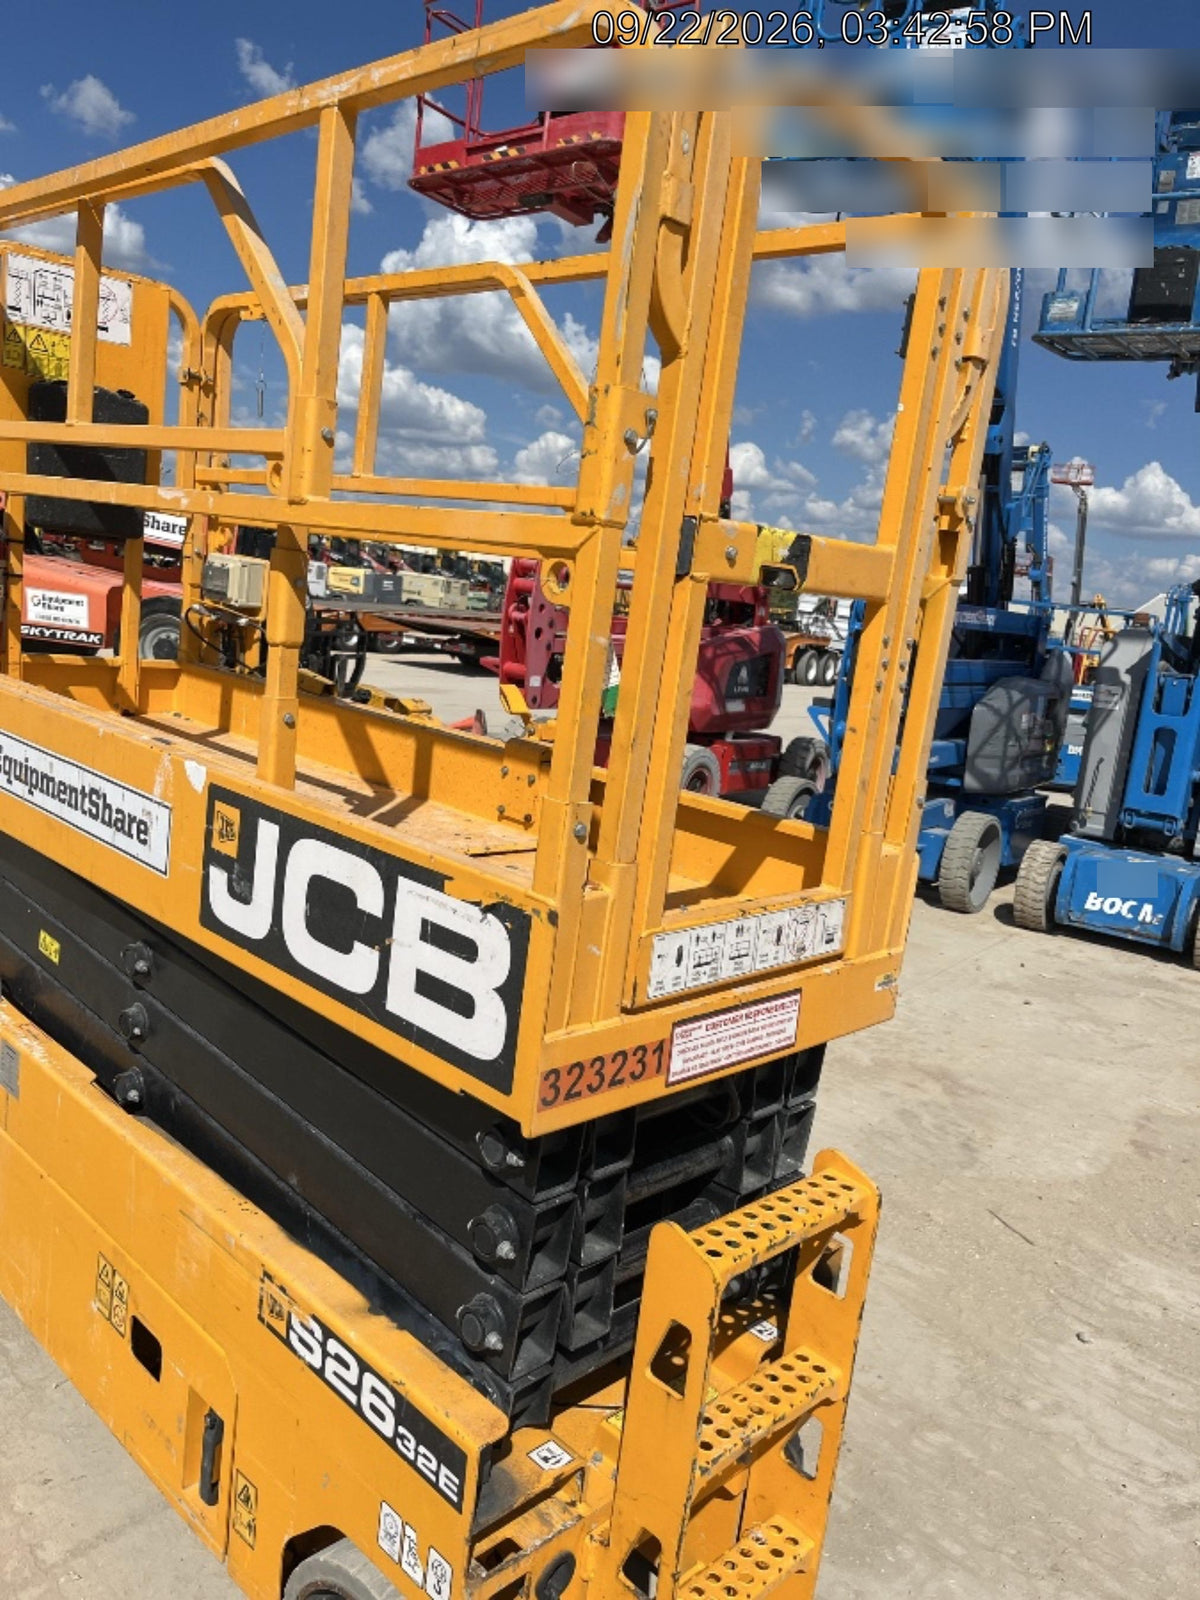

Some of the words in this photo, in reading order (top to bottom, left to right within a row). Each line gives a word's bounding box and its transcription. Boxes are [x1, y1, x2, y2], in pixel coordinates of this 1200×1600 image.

[21, 626, 101, 644] SKYTRAK
[0, 744, 148, 846] quipmentShare
[209, 818, 511, 1061] JCB
[541, 1038, 665, 1106] 323231
[289, 1311, 396, 1439] S26
[396, 1425, 460, 1503] 32E
